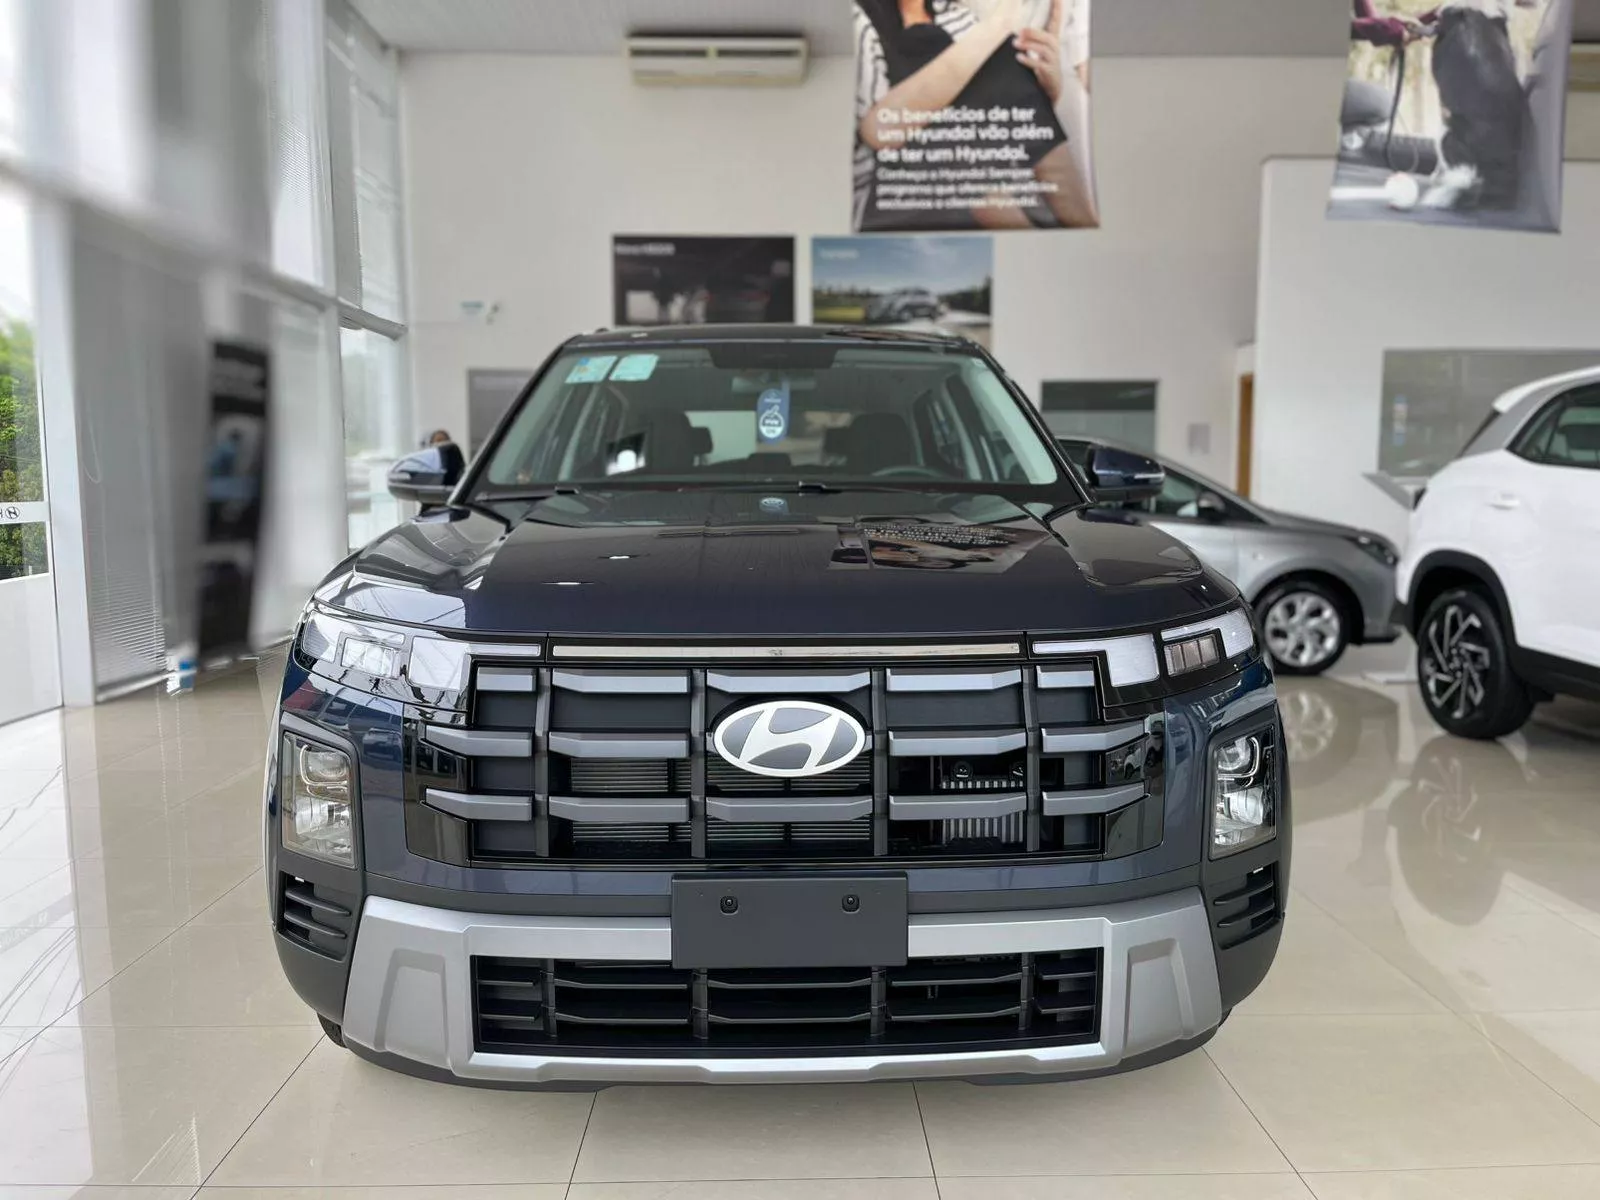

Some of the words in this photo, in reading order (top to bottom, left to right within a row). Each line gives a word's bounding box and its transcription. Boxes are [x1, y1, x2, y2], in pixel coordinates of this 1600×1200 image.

[876, 108, 899, 124] Os
[988, 105, 1009, 122] de
[1011, 106, 1035, 121] ter
[877, 128, 905, 142] um
[907, 125, 976, 145] Hyundai
[978, 124, 1010, 140] vão
[1012, 123, 1054, 140] além
[876, 146, 899, 162] de
[900, 147, 923, 163] ter
[924, 148, 954, 162] um
[955, 144, 1030, 164] Hyundai.
